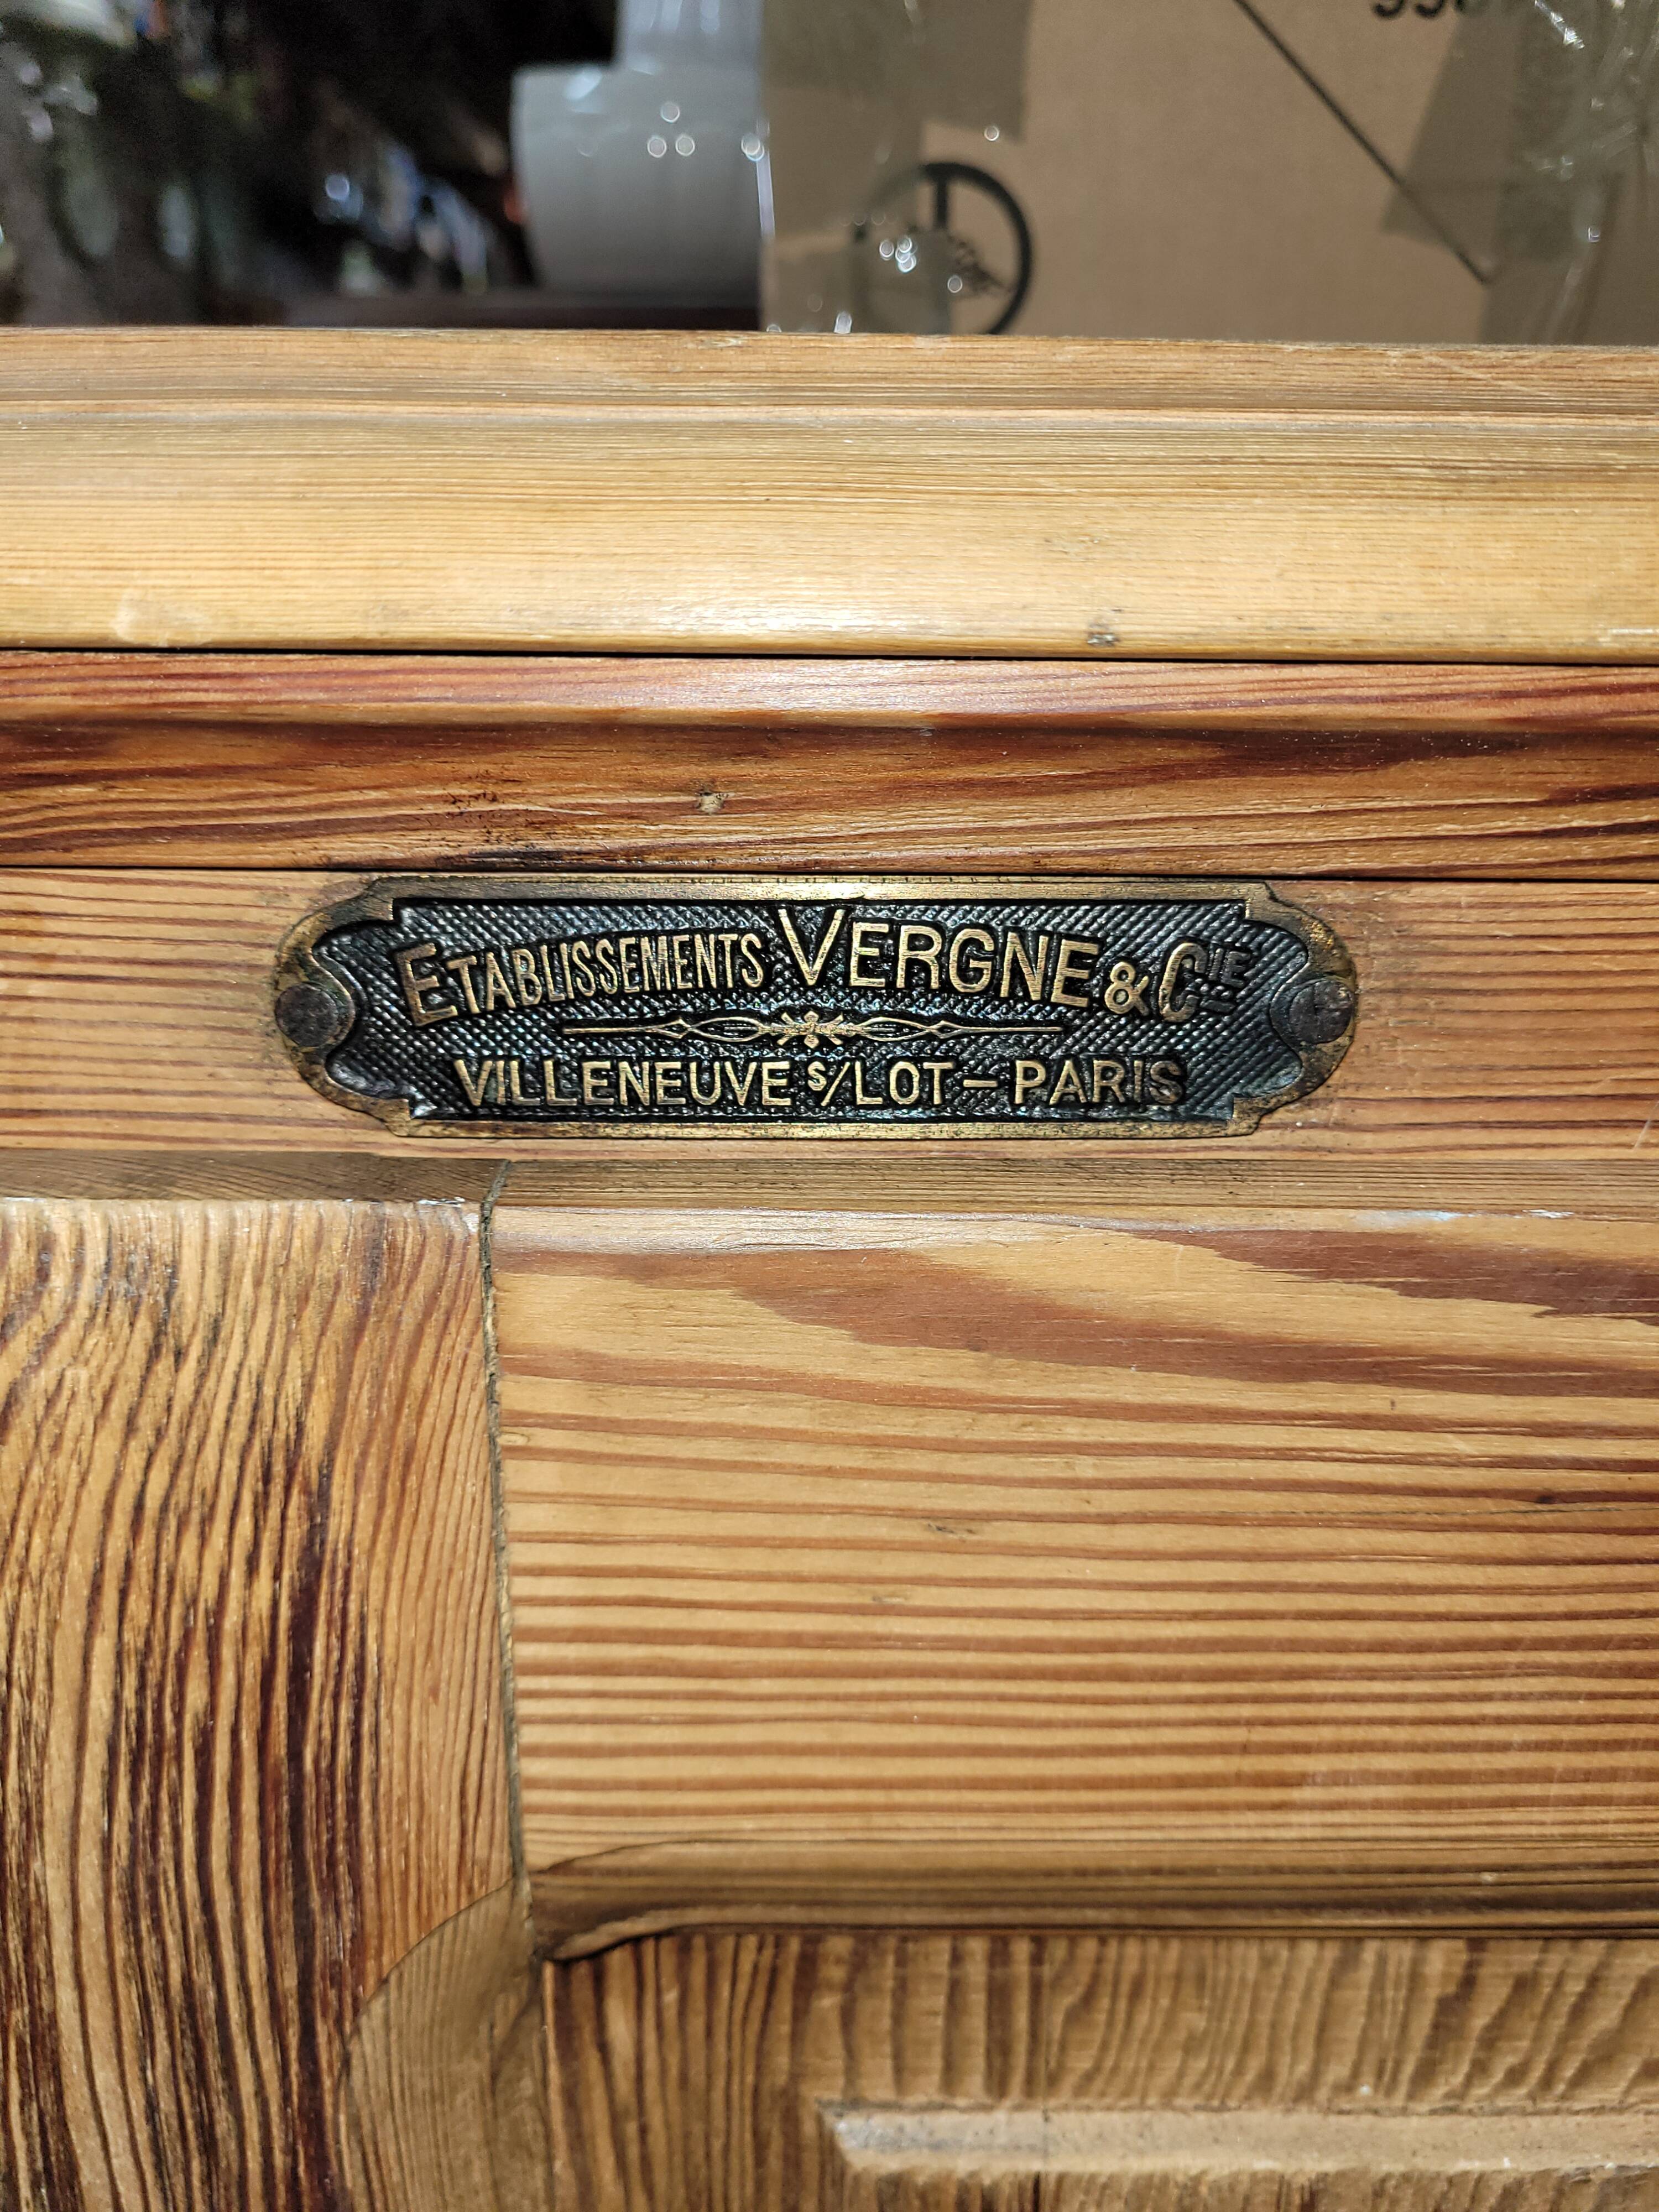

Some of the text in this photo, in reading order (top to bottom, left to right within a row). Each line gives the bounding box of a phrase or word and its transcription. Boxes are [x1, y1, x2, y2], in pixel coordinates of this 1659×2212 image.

[394, 932, 764, 1027] ETABLISSEMENTS
[778, 908, 1100, 1008] VERGNE
[1104, 961, 1150, 1016] &
[453, 1058, 791, 1107] VILLENEUVE
[1013, 1059, 1185, 1105] PARIS
